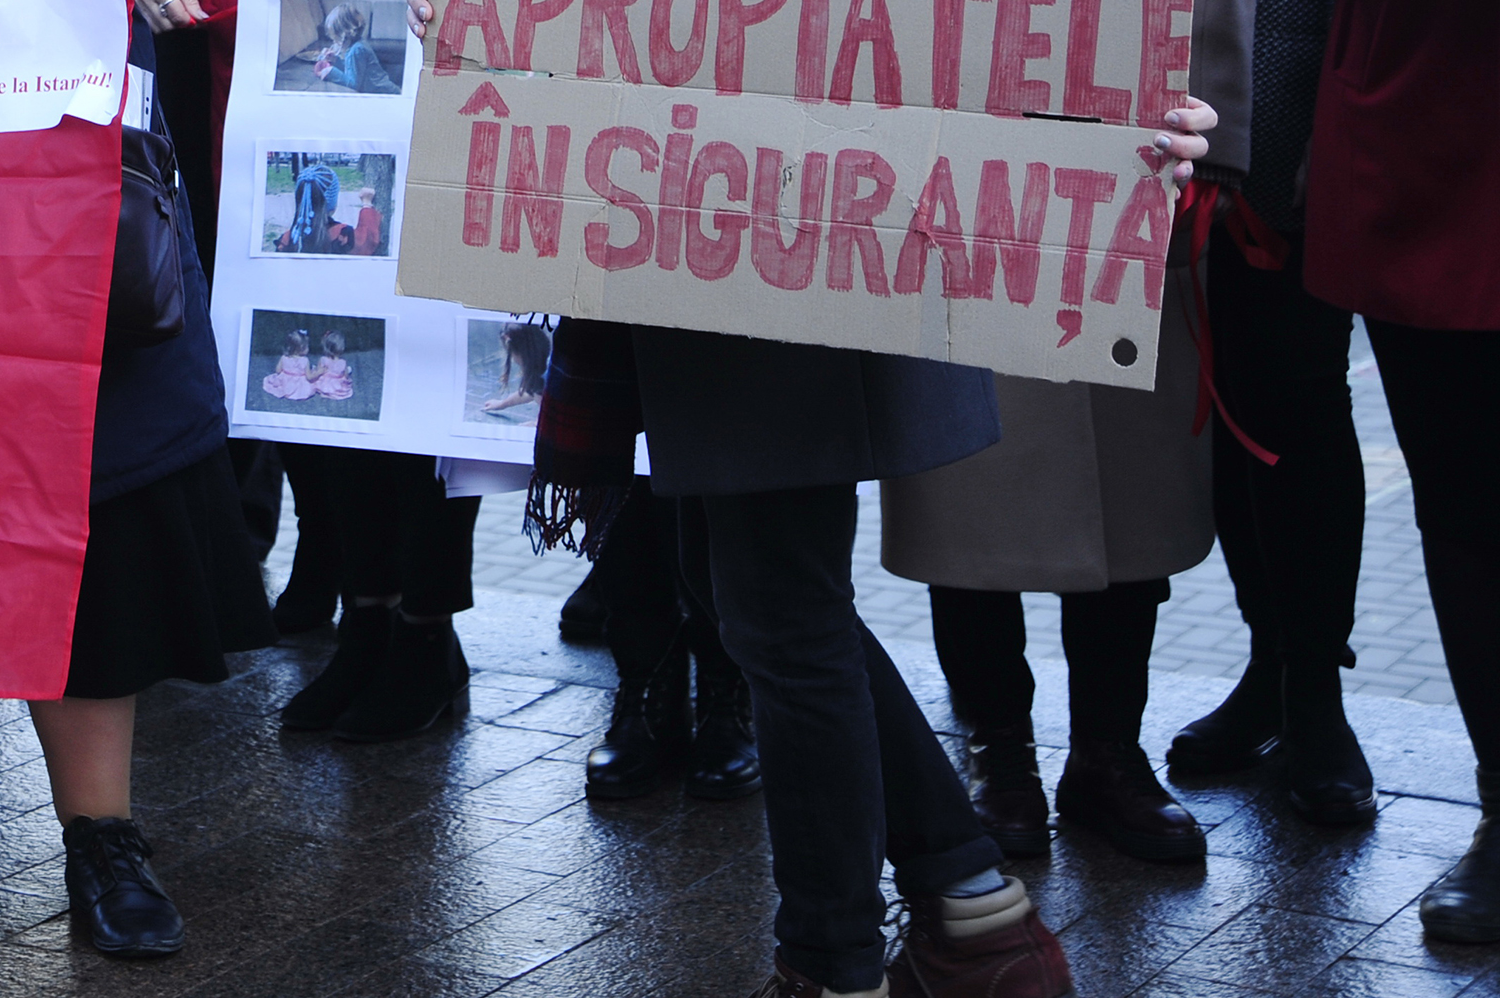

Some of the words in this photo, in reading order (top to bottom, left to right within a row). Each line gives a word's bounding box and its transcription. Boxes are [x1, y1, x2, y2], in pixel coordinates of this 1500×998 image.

[12, 74, 29, 94] la
[458, 81, 571, 258] ÎN
[584, 105, 1173, 348] SIGURANȚĂ
